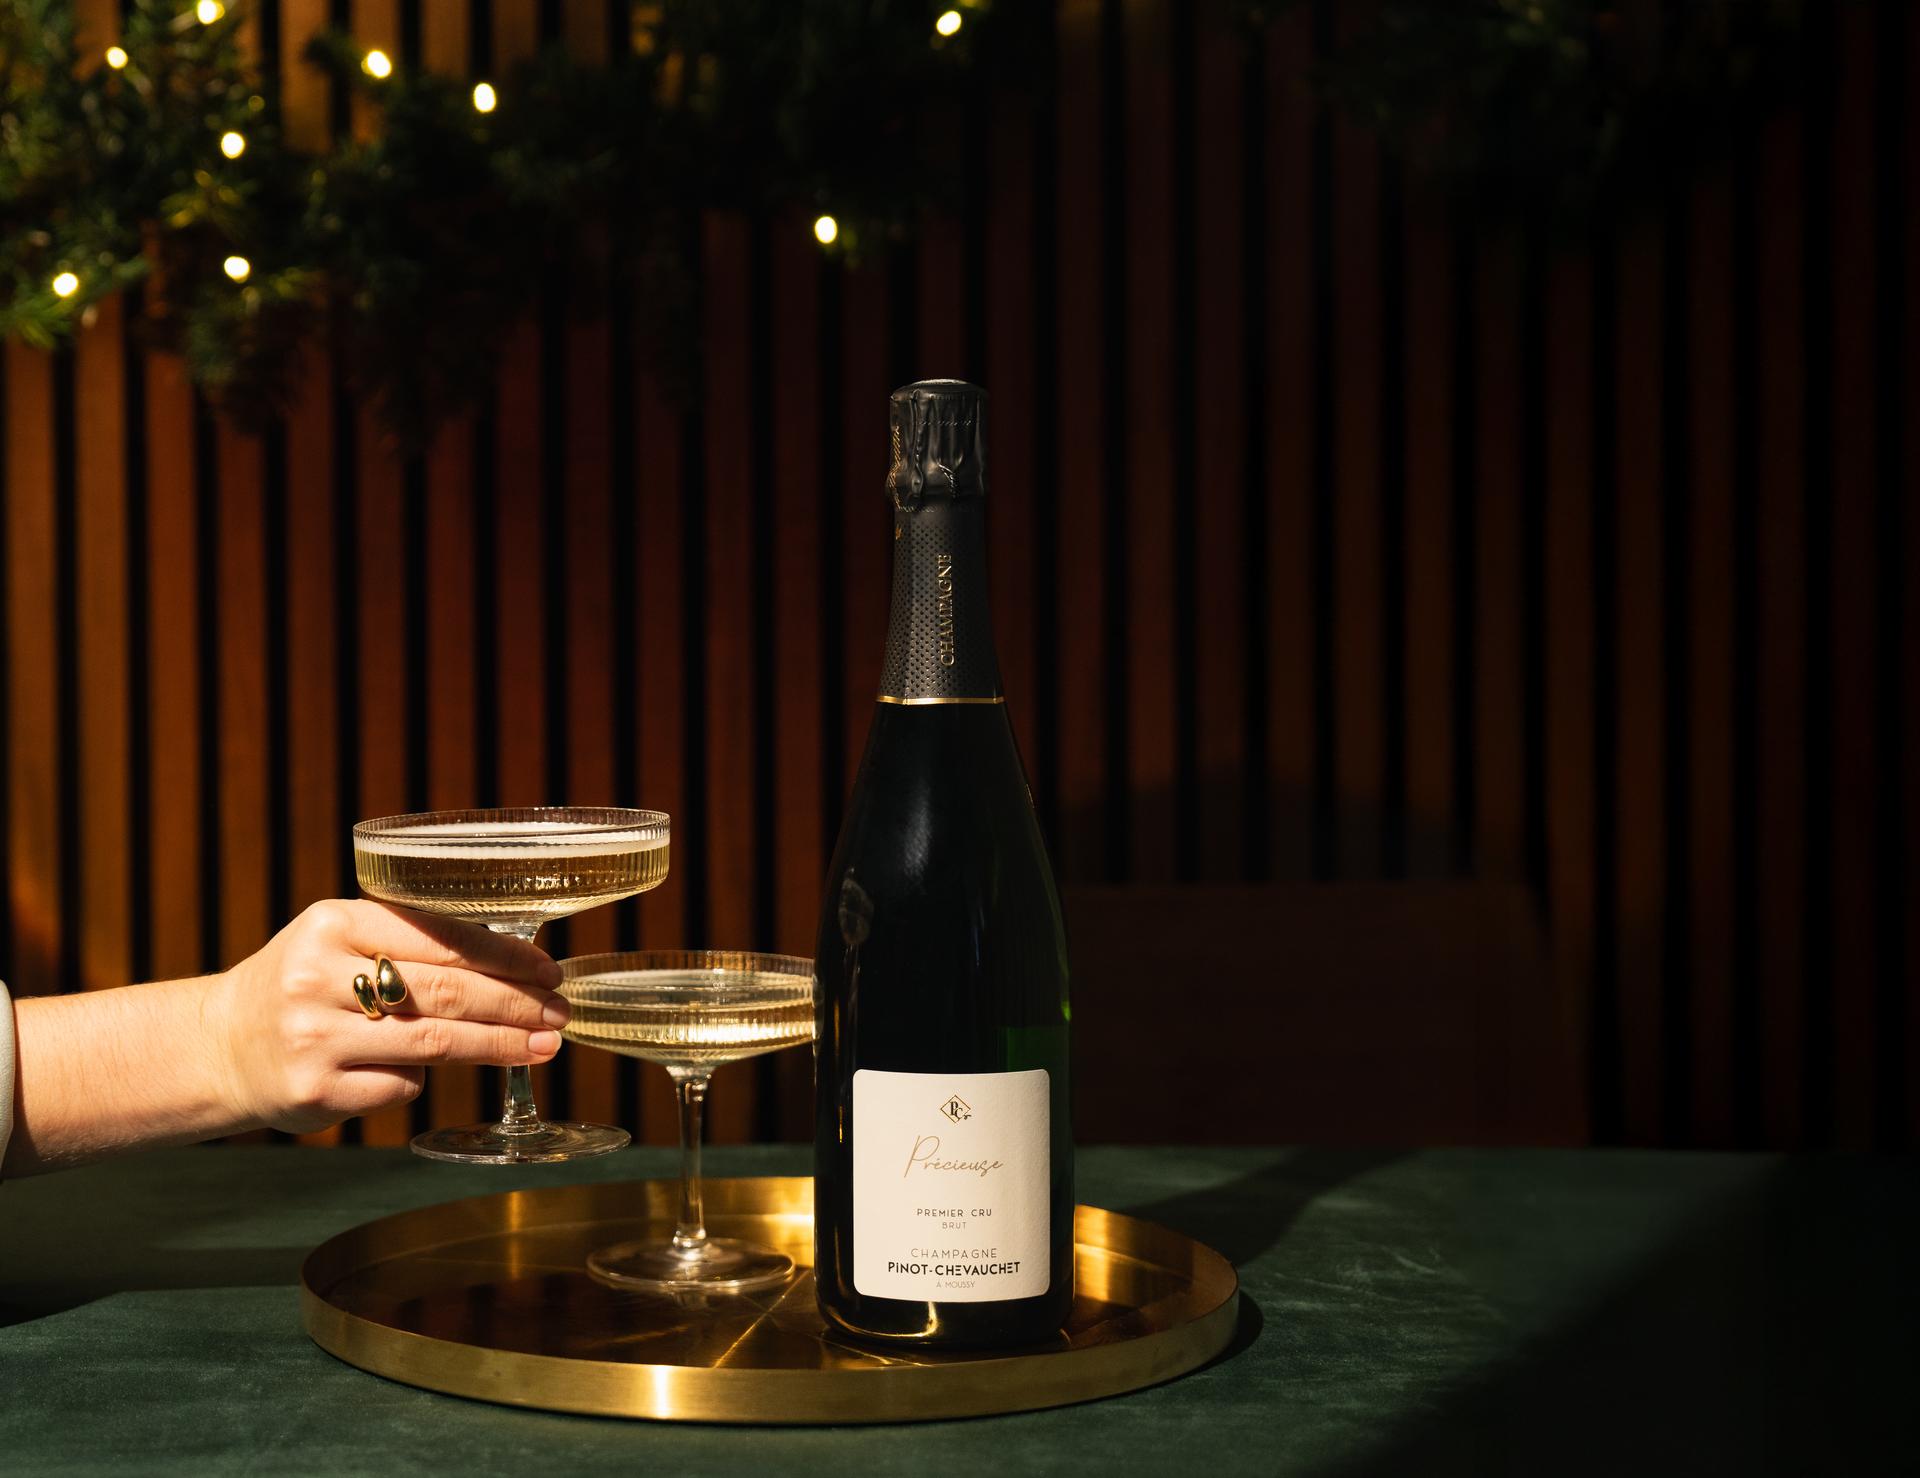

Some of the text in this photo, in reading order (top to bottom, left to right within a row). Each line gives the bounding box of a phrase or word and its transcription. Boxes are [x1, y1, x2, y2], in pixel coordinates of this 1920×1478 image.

[937, 555, 955, 666] CHAMPAGNE
[904, 1135, 1004, 1178] Précieuse
[917, 1208, 992, 1217] PREMIER CRU
[942, 1221, 967, 1229] BRUT
[910, 1248, 998, 1259] CHAMPAGNE
